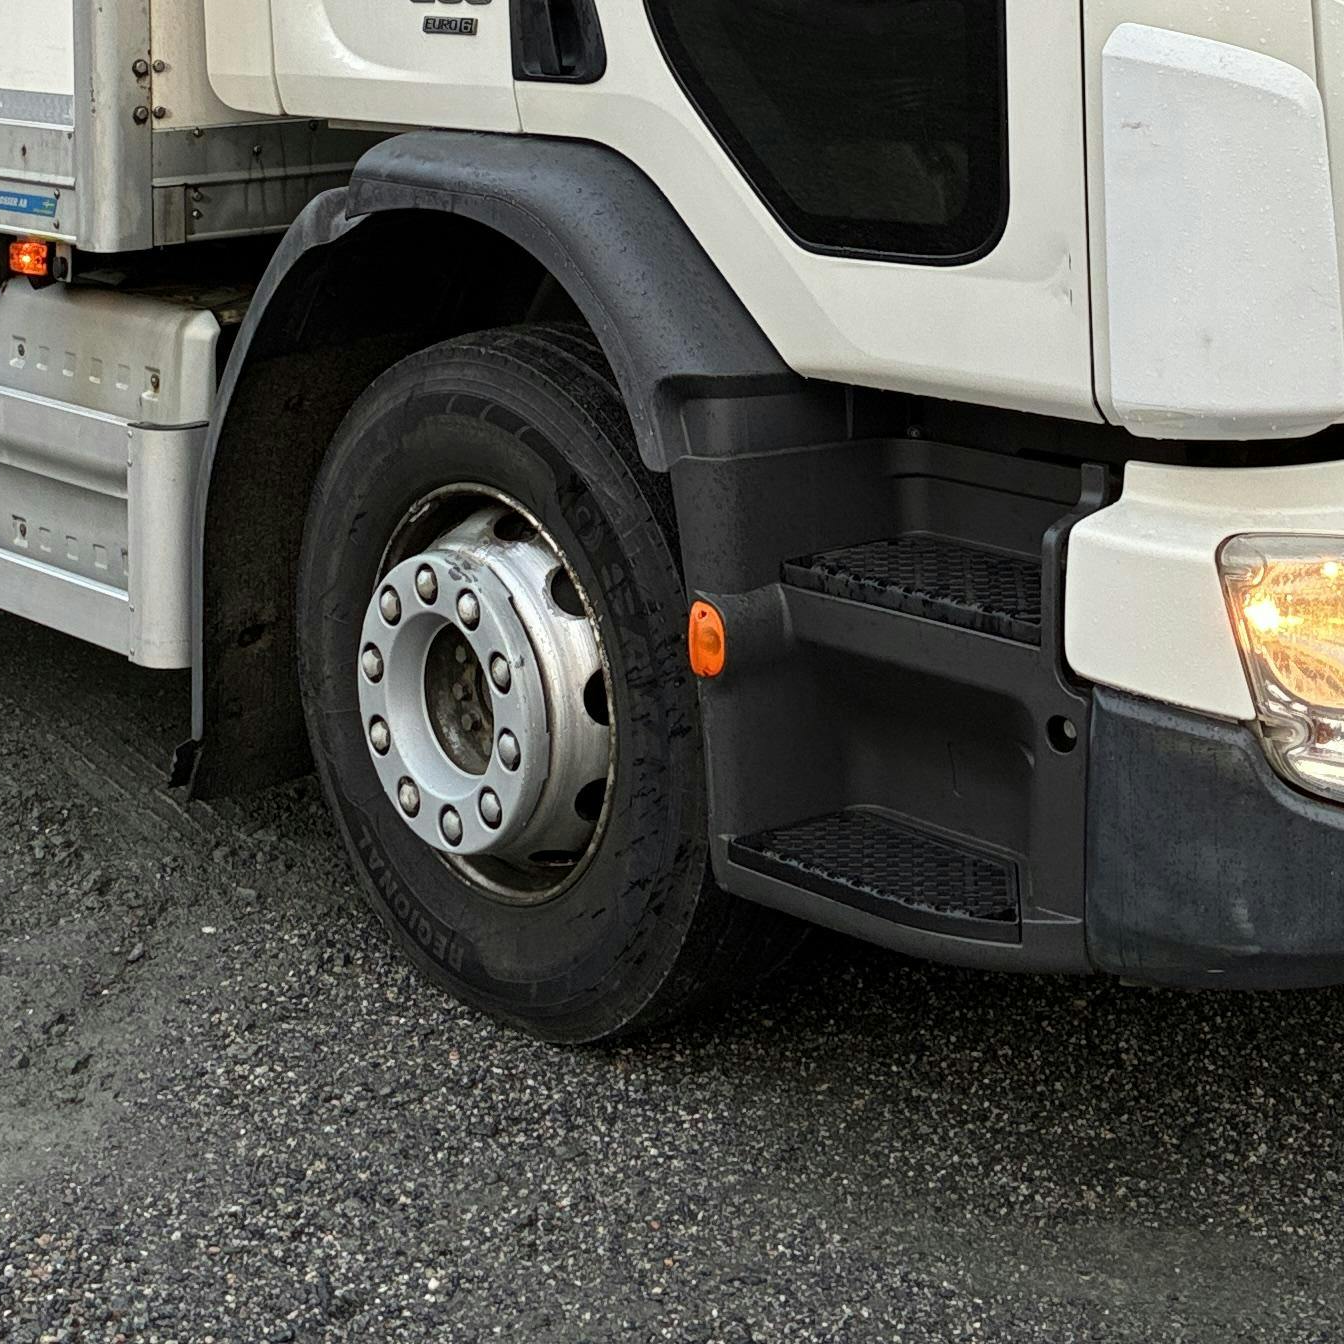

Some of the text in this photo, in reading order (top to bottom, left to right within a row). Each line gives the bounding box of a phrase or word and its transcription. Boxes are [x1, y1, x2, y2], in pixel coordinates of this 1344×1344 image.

[424, 17, 473, 33] EURO 6
[358, 824, 465, 973] REGIONAL
